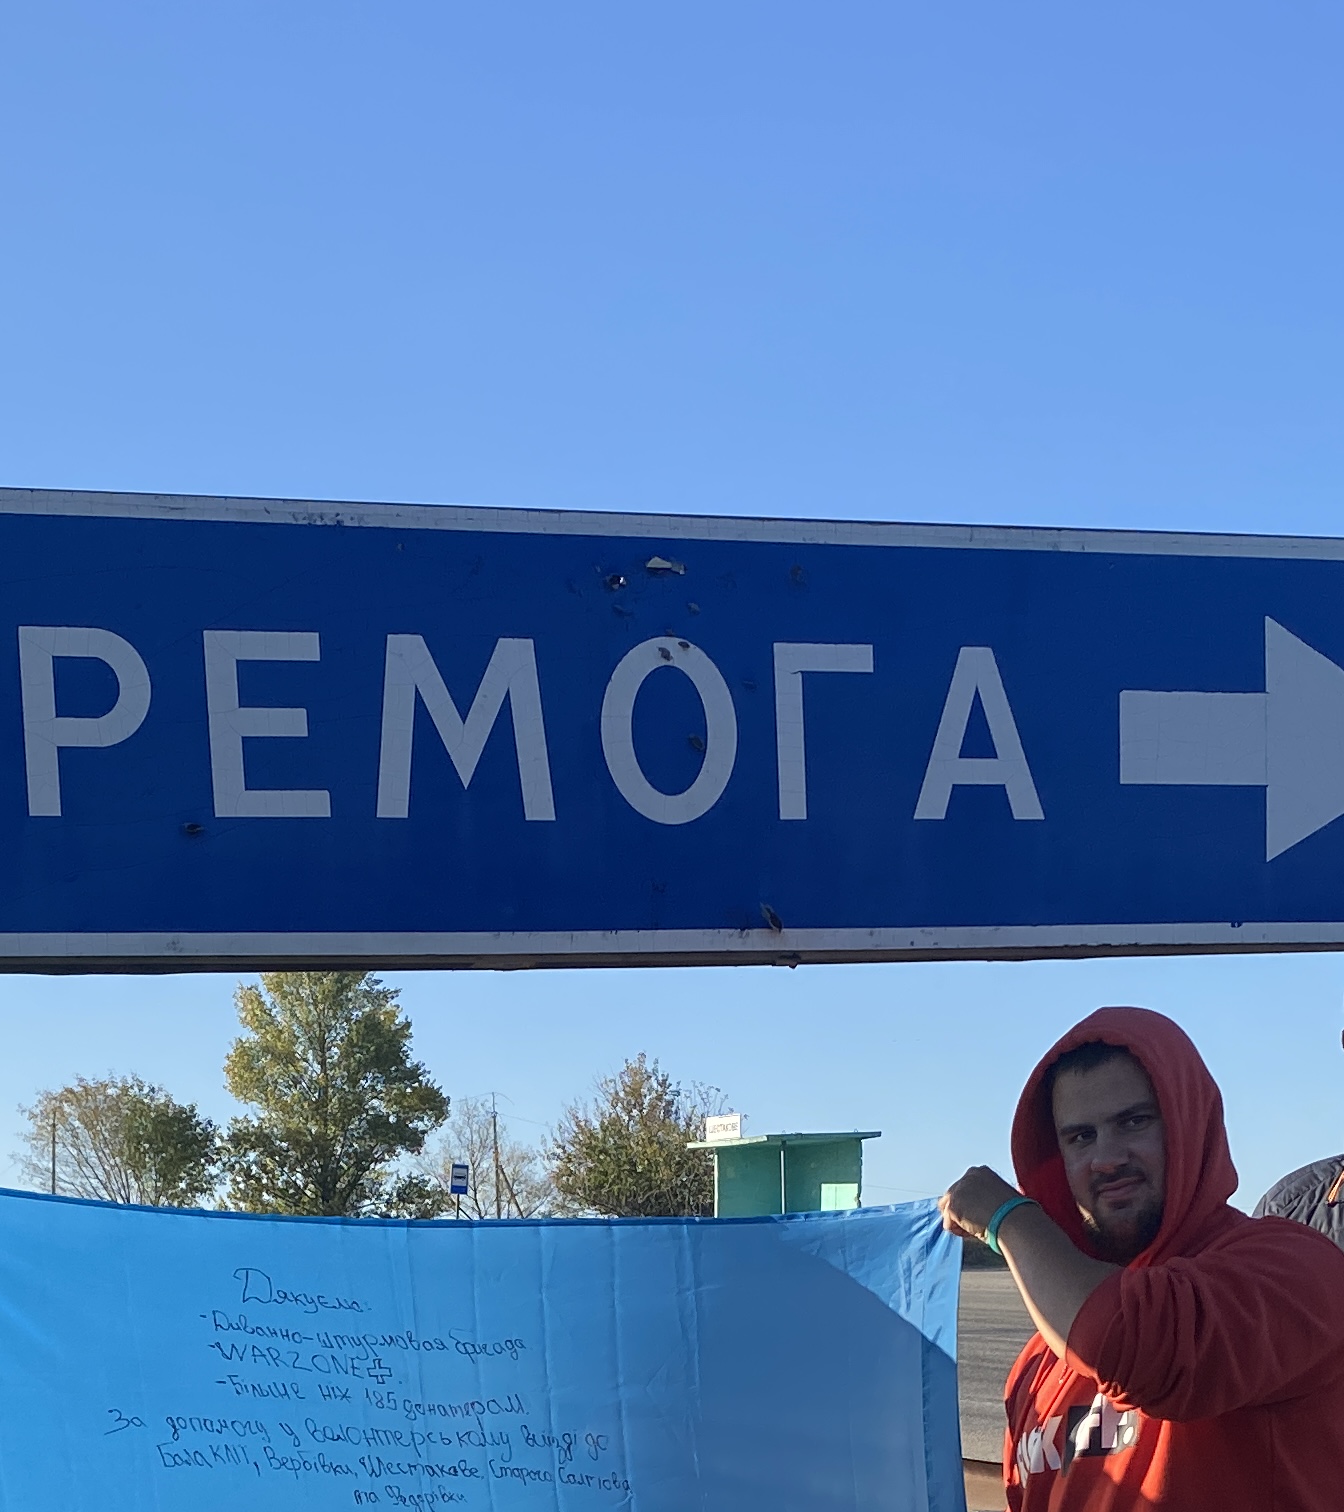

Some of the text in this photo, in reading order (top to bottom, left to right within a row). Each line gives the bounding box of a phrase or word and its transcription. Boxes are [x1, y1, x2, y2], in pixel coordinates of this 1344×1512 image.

[364, 1388, 398, 1411] 185
[104, 1408, 148, 1436] За
[279, 1421, 301, 1448] у
[585, 1431, 609, 1461] до
